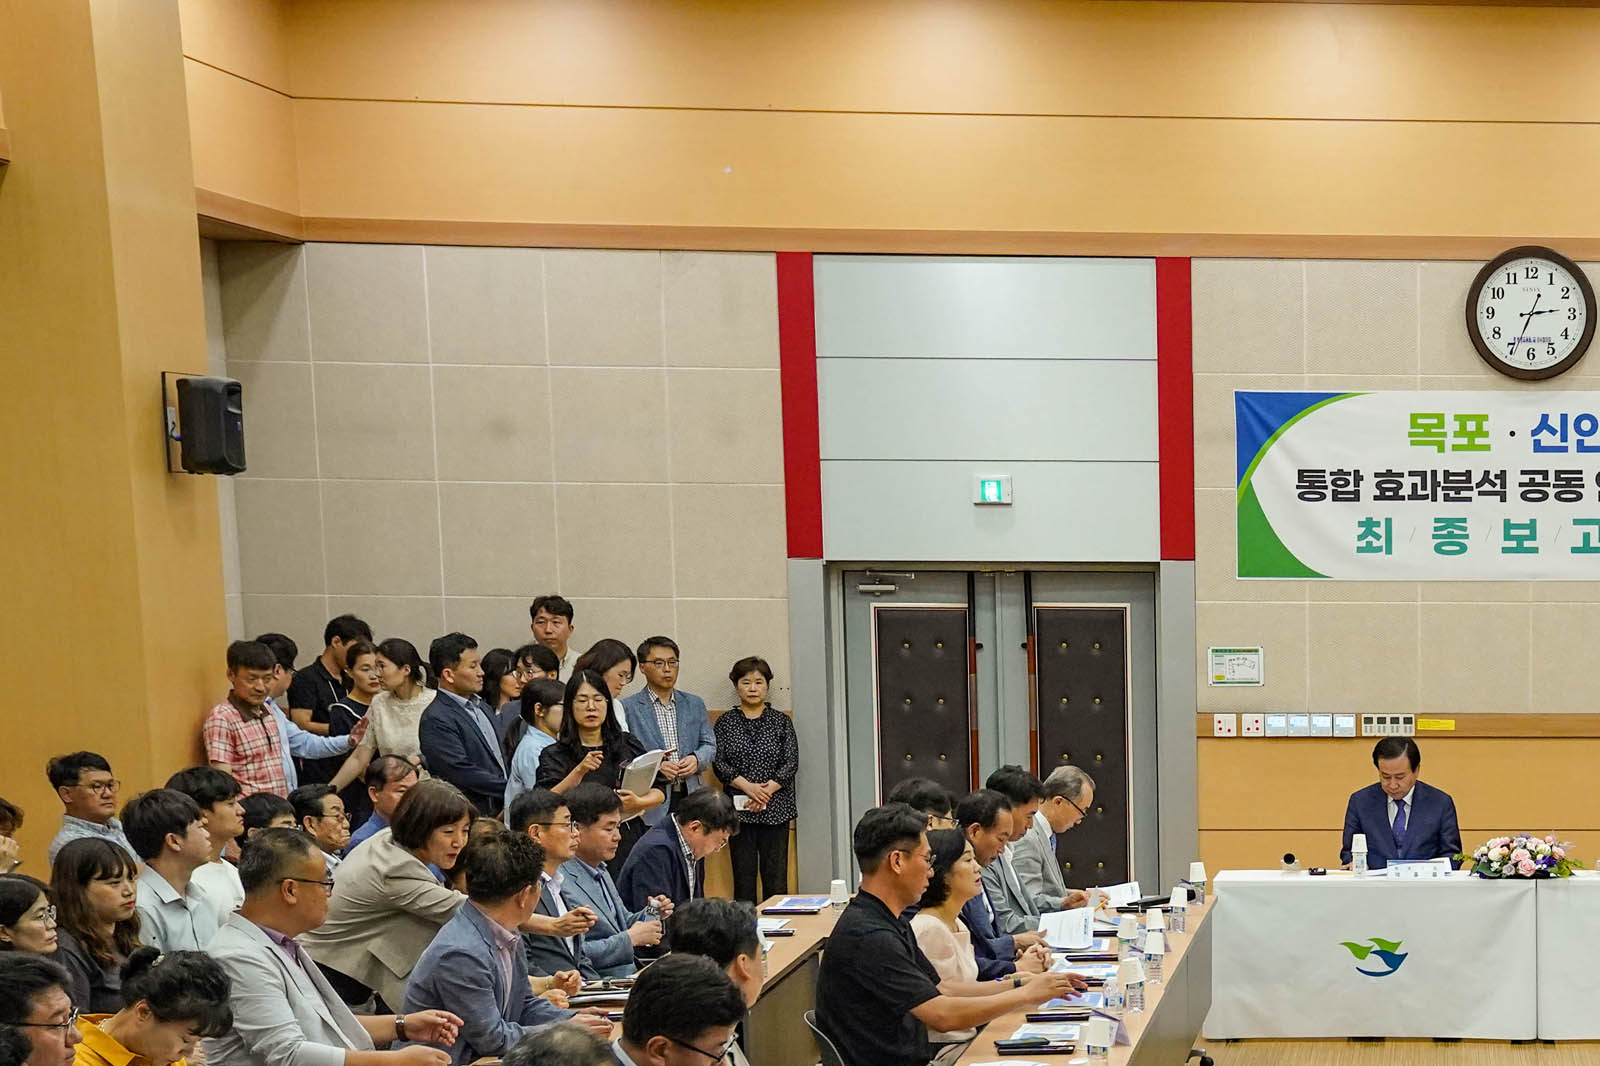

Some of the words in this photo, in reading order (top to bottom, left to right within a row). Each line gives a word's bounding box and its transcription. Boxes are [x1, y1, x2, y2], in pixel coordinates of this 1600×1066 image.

[1505, 272, 1518, 285] 11
[1524, 266, 1539, 280] 12
[1547, 272, 1555, 285] 1
[1490, 286, 1505, 300] 10
[1560, 286, 1570, 299] 2
[1485, 306, 1495, 319] 9
[1567, 307, 1577, 321] 3
[1492, 326, 1501, 340] 8
[1560, 327, 1569, 340] 4
[1506, 342, 1516, 355] 7
[1526, 347, 1536, 361] 6
[1546, 342, 1556, 355] 5
[1407, 412, 1492, 454] 목포
[1295, 468, 1364, 503] 통합
[1372, 468, 1507, 503] 효과분석
[1518, 469, 1585, 503] 공동
